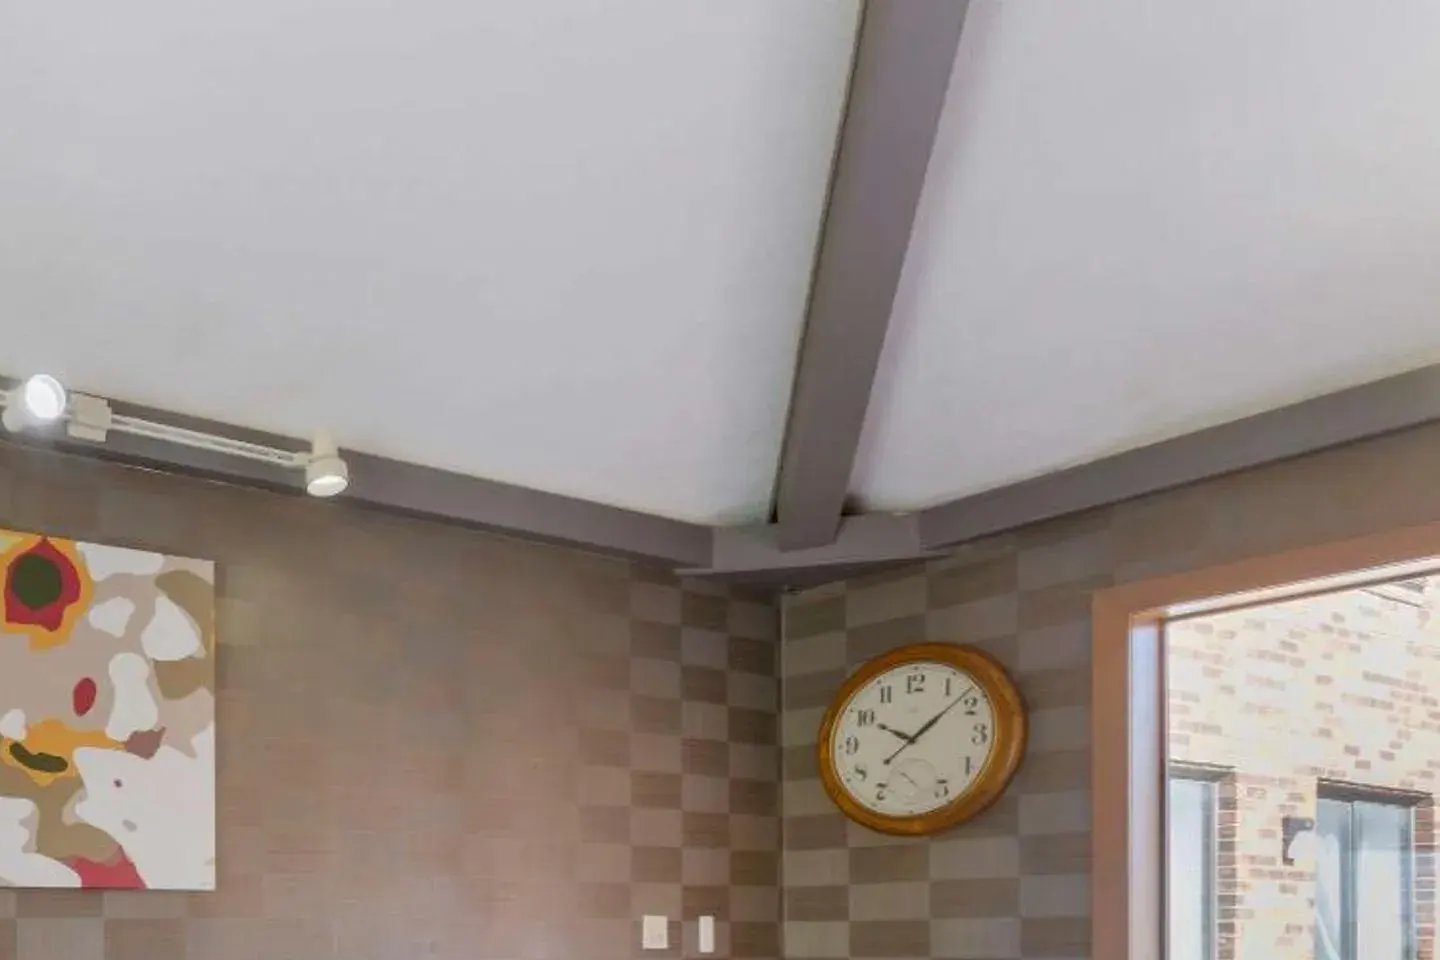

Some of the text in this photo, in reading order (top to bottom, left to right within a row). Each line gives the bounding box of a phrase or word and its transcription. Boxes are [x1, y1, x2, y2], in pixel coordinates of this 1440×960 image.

[906, 673, 926, 695] 12
[944, 677, 952, 697] 1
[879, 685, 893, 704] 11
[963, 696, 979, 717] 2
[857, 709, 876, 728] 10
[971, 722, 989, 747] 3
[846, 736, 860, 756] 9
